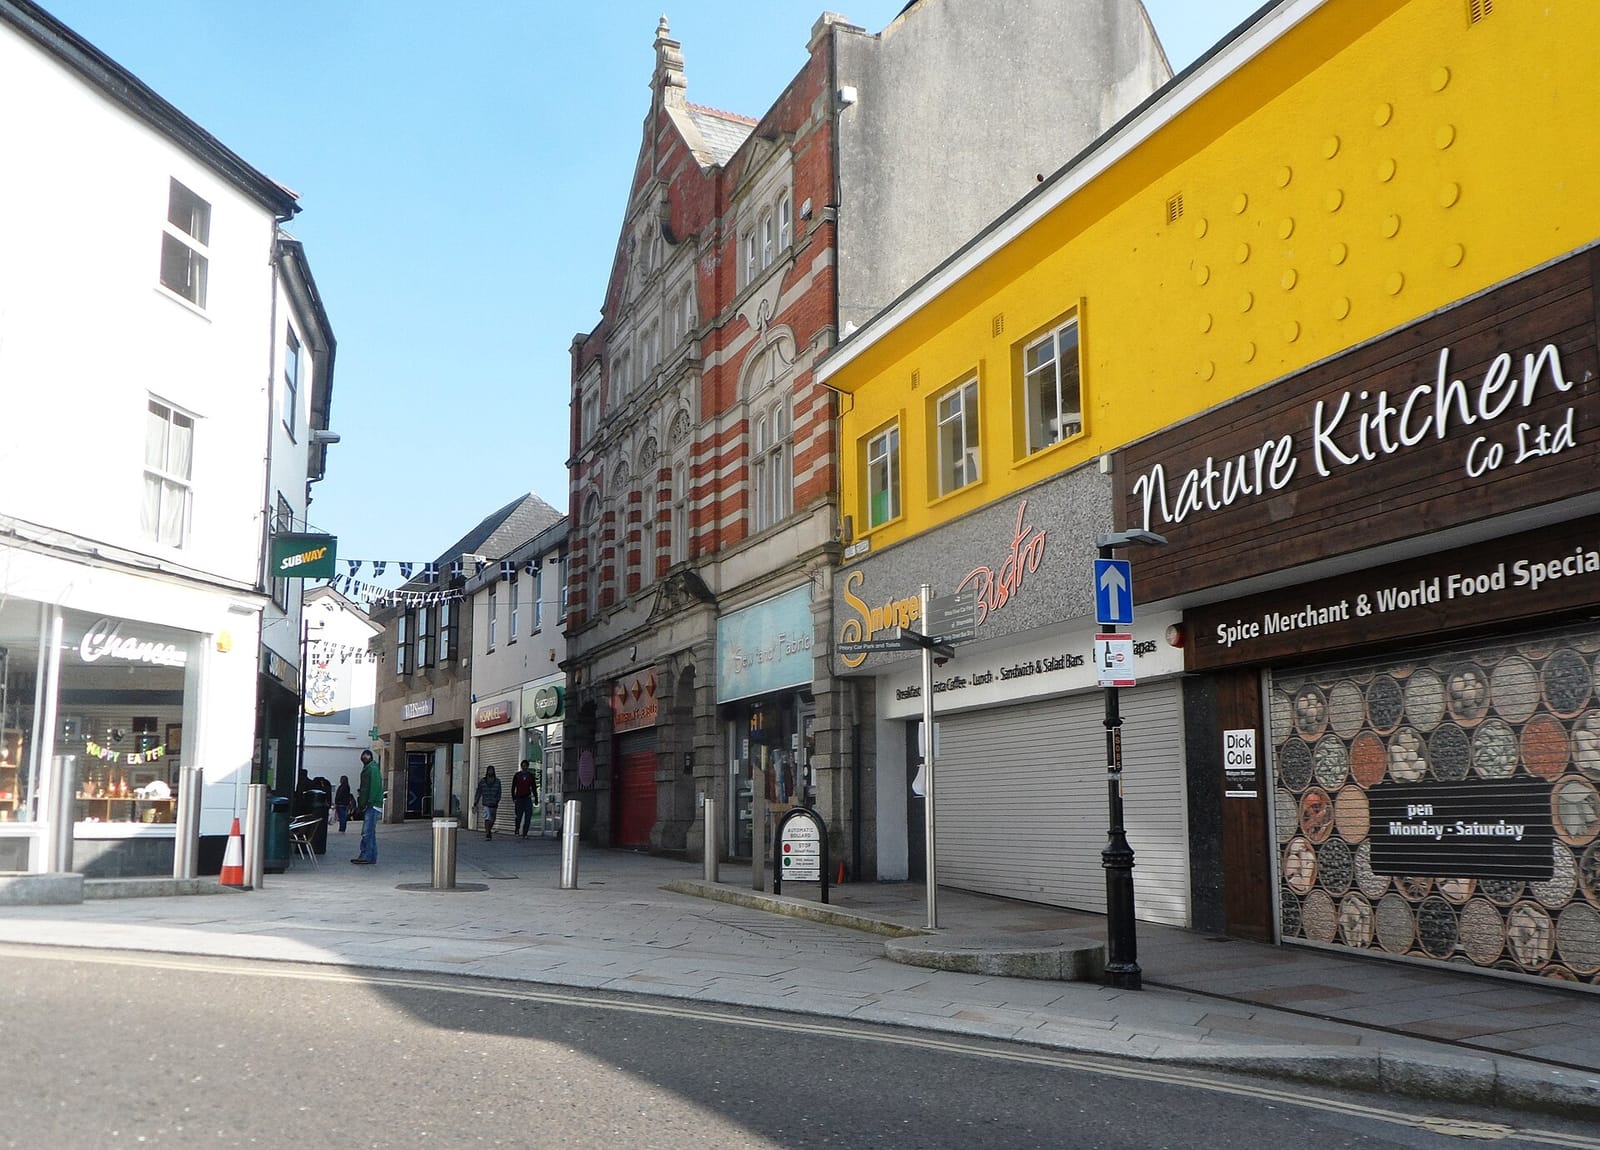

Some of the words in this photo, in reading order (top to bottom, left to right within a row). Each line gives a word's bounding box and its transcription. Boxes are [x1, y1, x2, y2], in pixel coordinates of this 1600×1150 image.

[1133, 434, 1297, 531] Nature
[1314, 344, 1574, 476] Kitchen
[1466, 436, 1503, 478] Co
[1515, 408, 1576, 464] Ltd
[280, 547, 327, 570] SUBWAY
[1216, 620, 1260, 648] Spice
[1264, 600, 1350, 635] Merchant
[1356, 593, 1372, 617] &
[1376, 577, 1441, 612] World
[1448, 563, 1505, 599] Food
[1513, 546, 1600, 590] Specia
[896, 685, 921, 701] Breakfast
[1000, 662, 1034, 681] Sandwich
[1042, 656, 1065, 673] Salad
[1065, 653, 1084, 668] Bars
[86, 741, 120, 762] HAPPY
[127, 745, 164, 764] EASTER
[1227, 734, 1252, 748] Dick
[1227, 750, 1252, 765] Cole
[1389, 821, 1444, 841] Monday
[1456, 821, 1525, 841] Saturday
